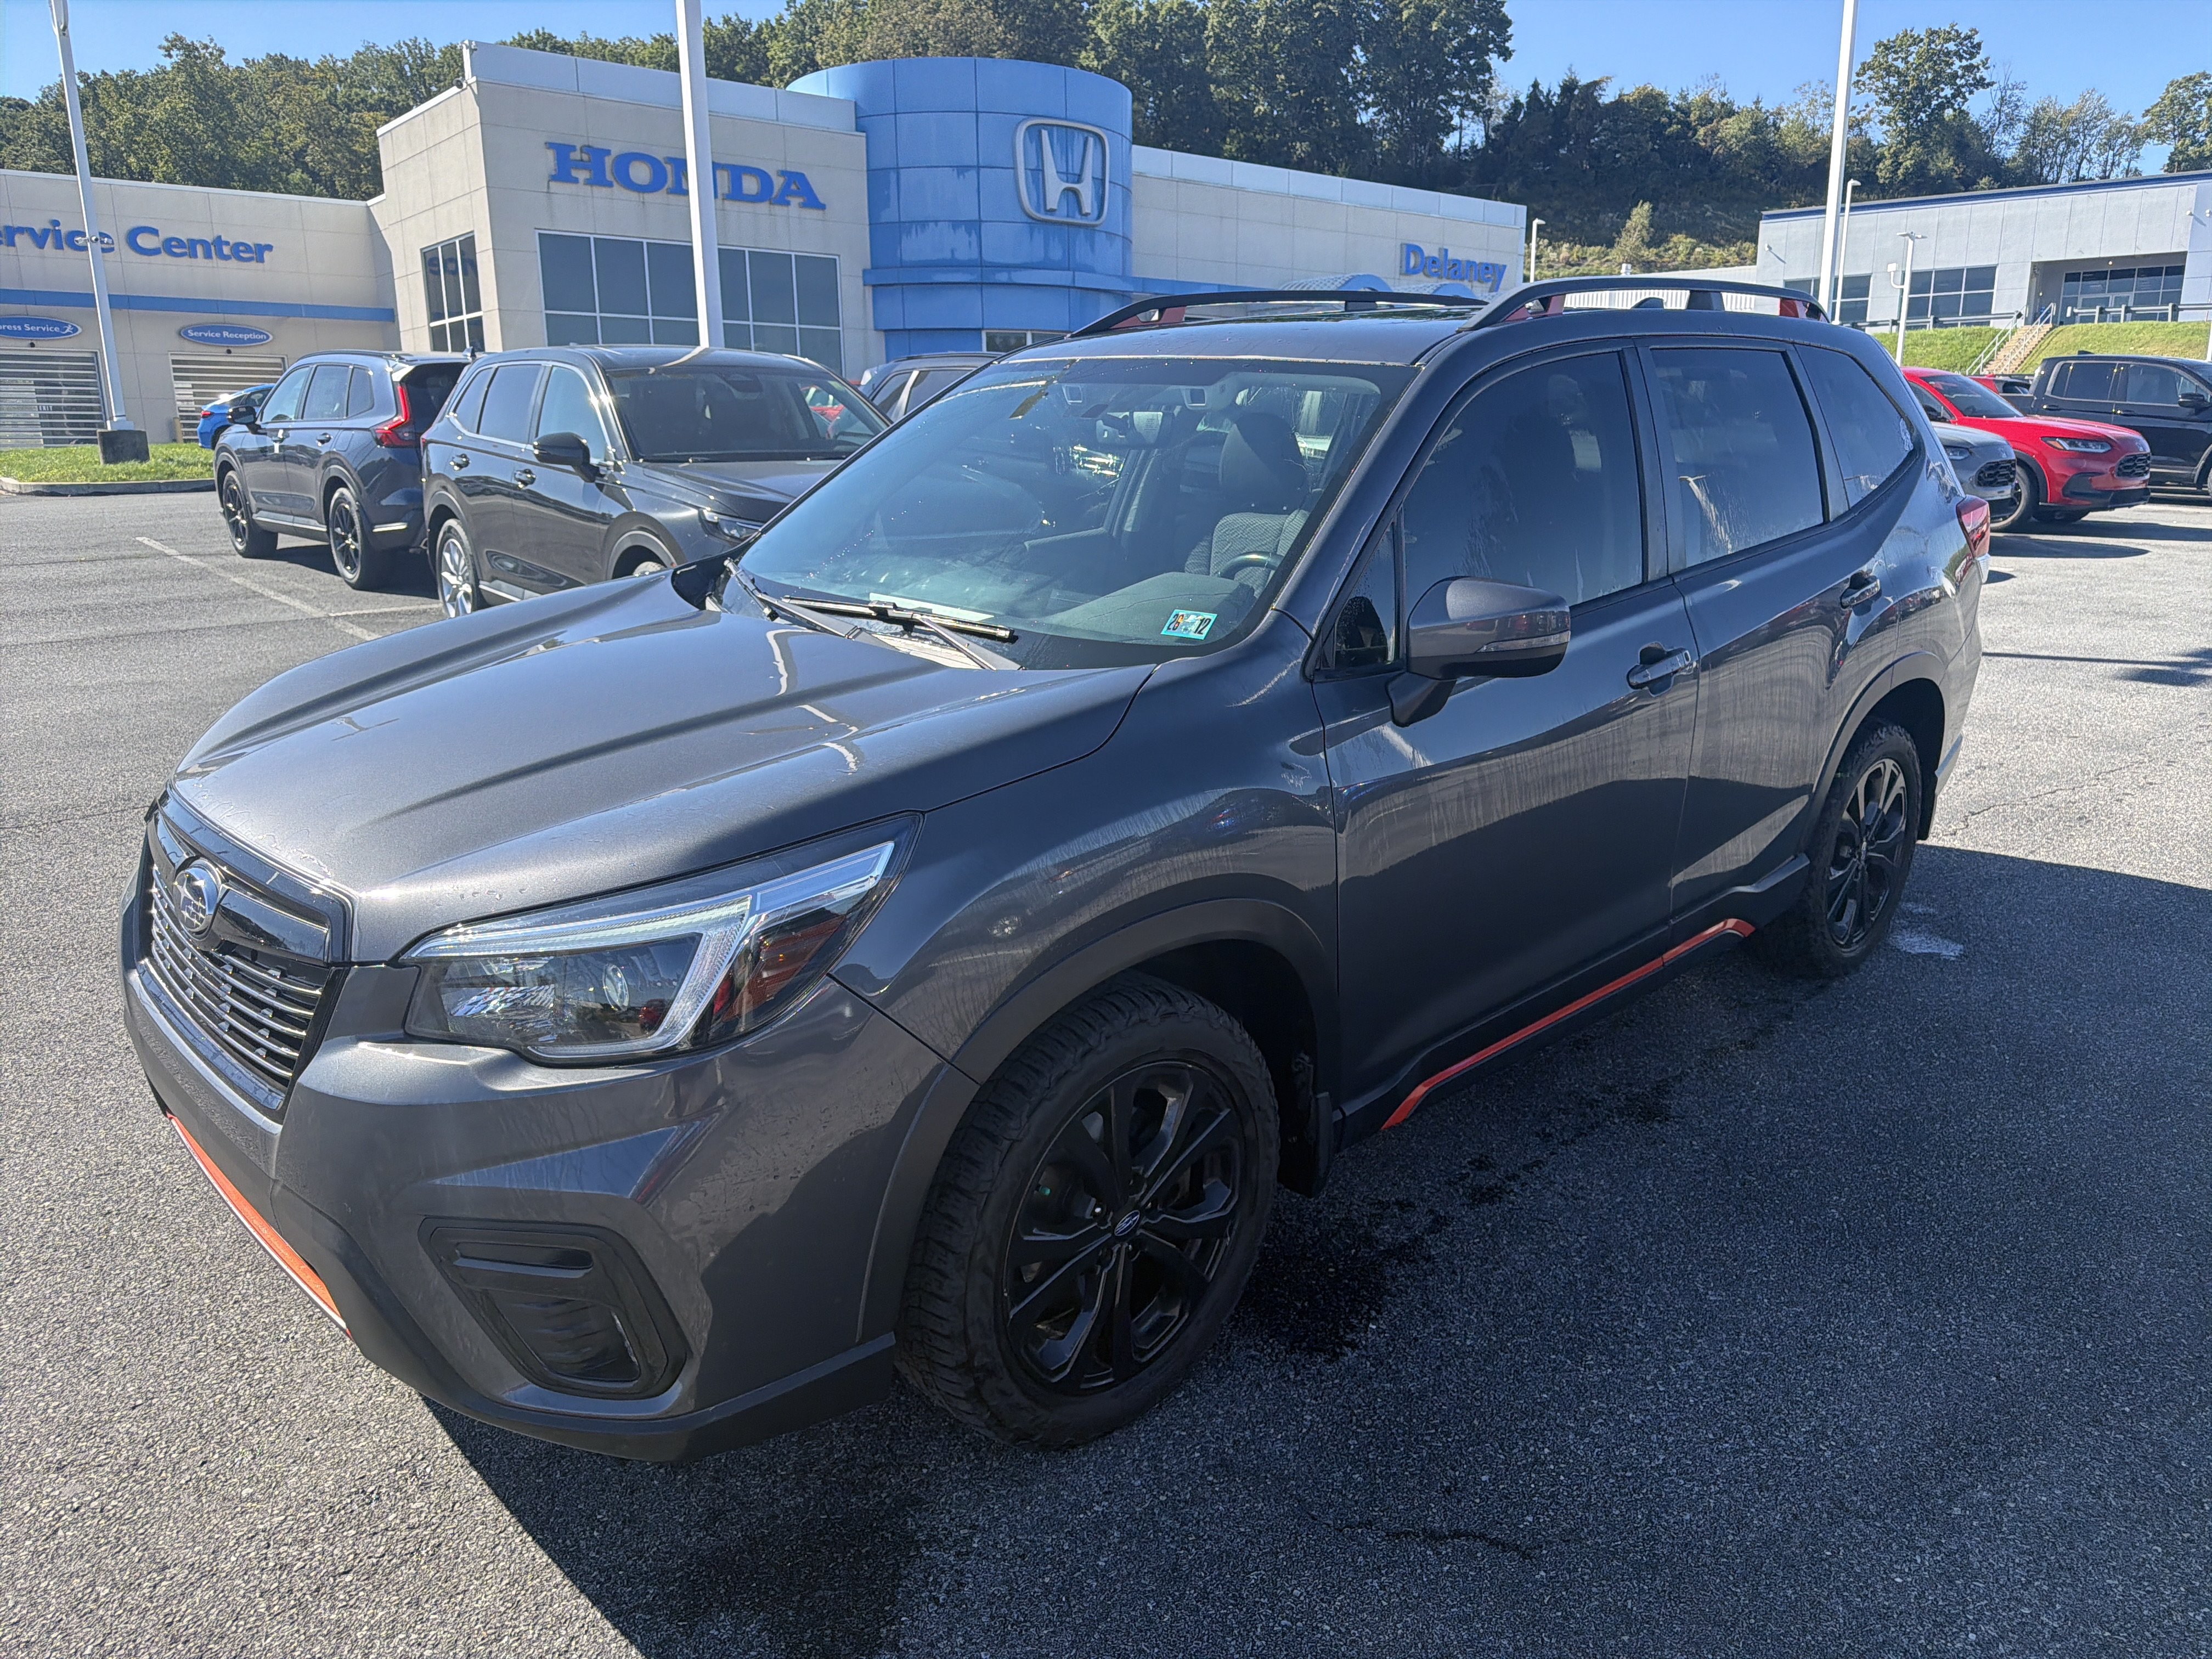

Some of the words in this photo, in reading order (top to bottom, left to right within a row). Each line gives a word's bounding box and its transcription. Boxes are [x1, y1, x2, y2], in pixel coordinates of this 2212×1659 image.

[544, 142, 826, 210] HONDA
[126, 225, 273, 263] Center
[1402, 243, 1507, 292] Delaney
[24, 324, 60, 332] Service
[188, 330, 221, 338] Service
[223, 331, 267, 340] Reception
[1193, 617, 1211, 635] 12
